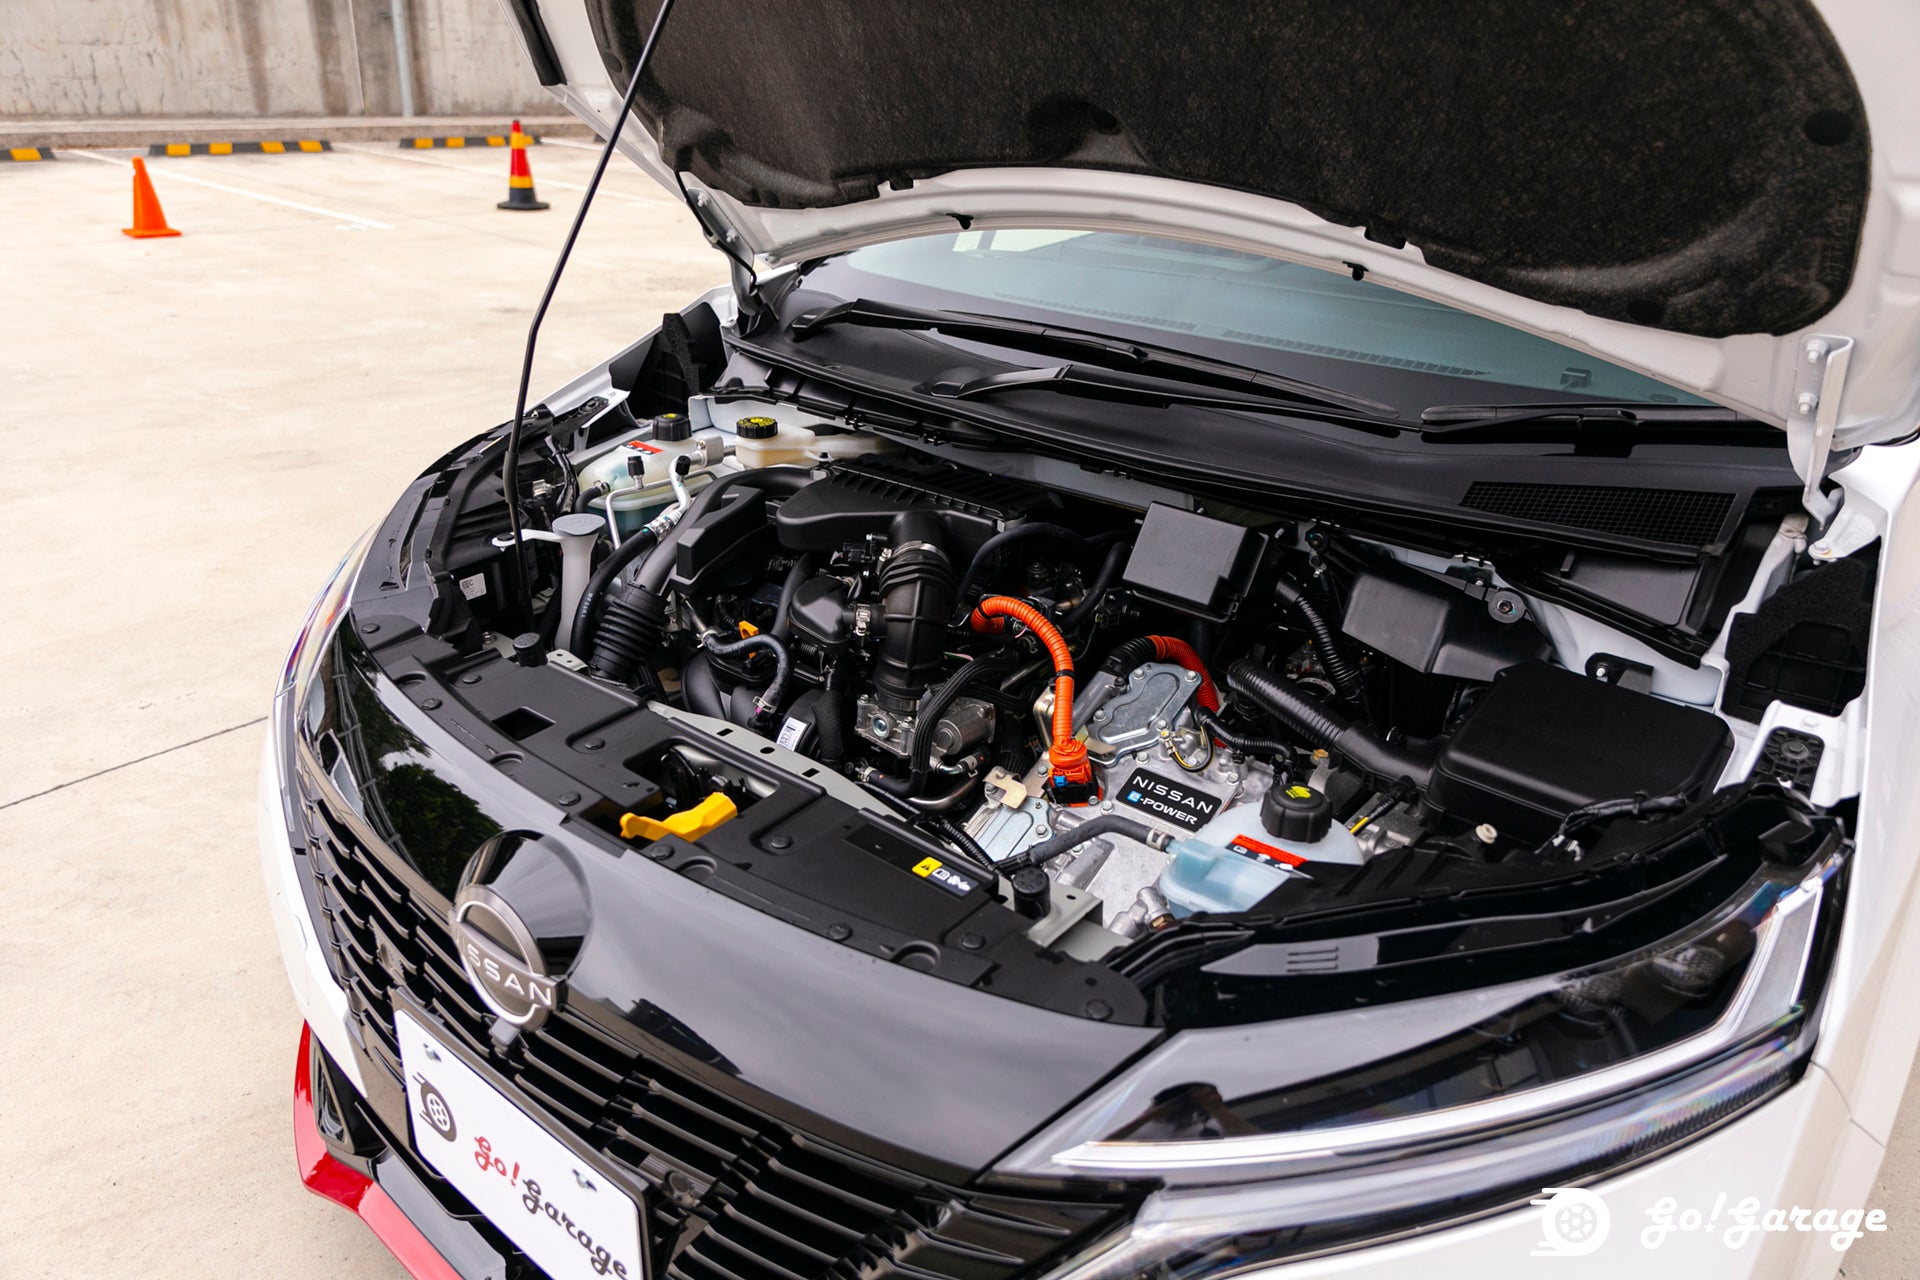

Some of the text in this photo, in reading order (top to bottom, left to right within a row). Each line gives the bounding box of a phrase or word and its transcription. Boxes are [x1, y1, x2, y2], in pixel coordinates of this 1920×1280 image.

[1127, 790, 1198, 825] e-POWER
[1132, 775, 1213, 814] NISSAN
[456, 936, 552, 1006] SSAN
